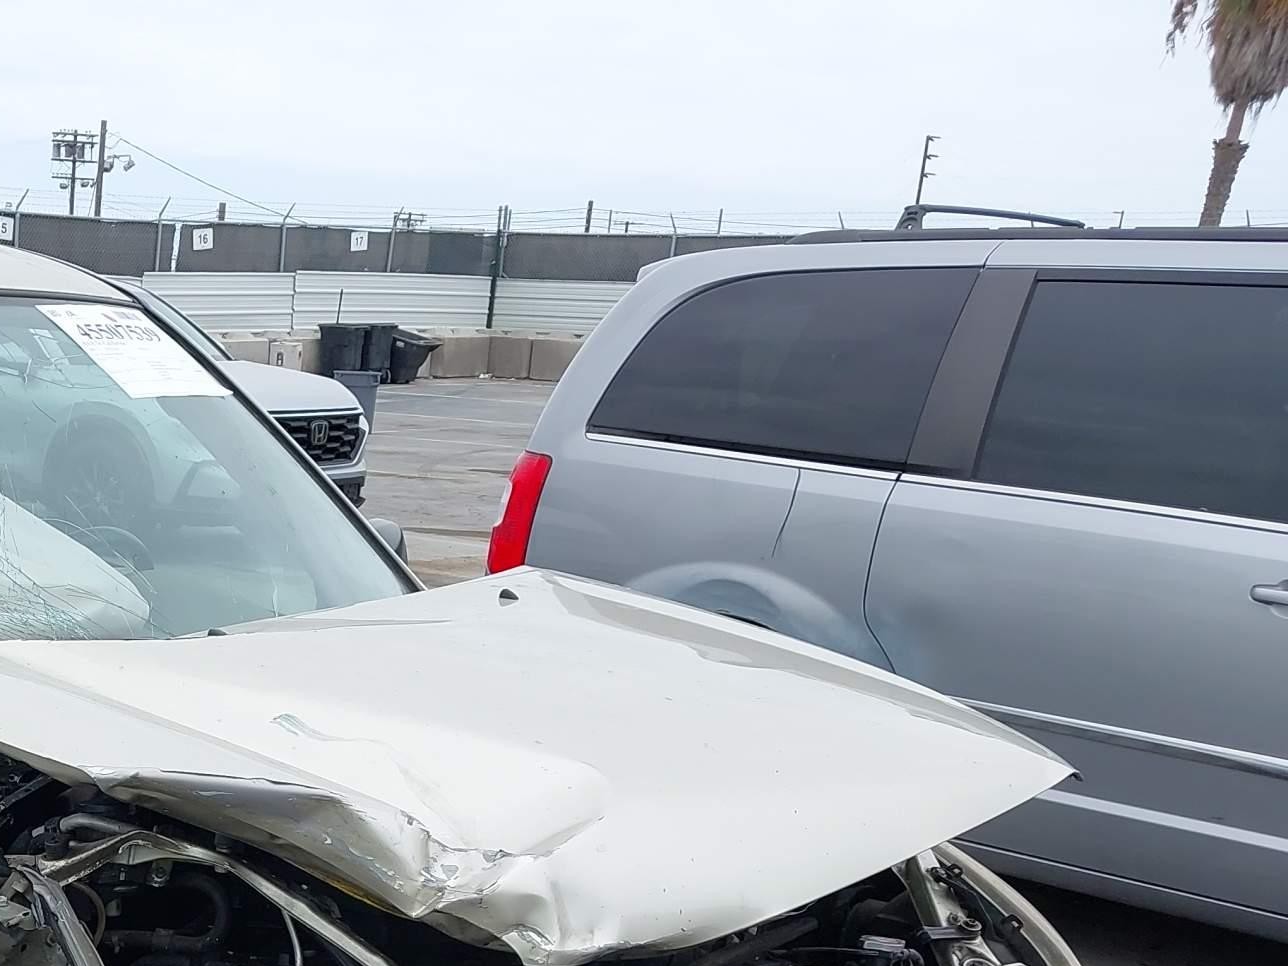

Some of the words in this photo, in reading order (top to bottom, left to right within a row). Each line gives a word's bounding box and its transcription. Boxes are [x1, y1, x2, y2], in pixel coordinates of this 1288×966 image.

[198, 233, 209, 245] 16
[355, 236, 364, 247] 17
[76, 323, 161, 342] 45507539
